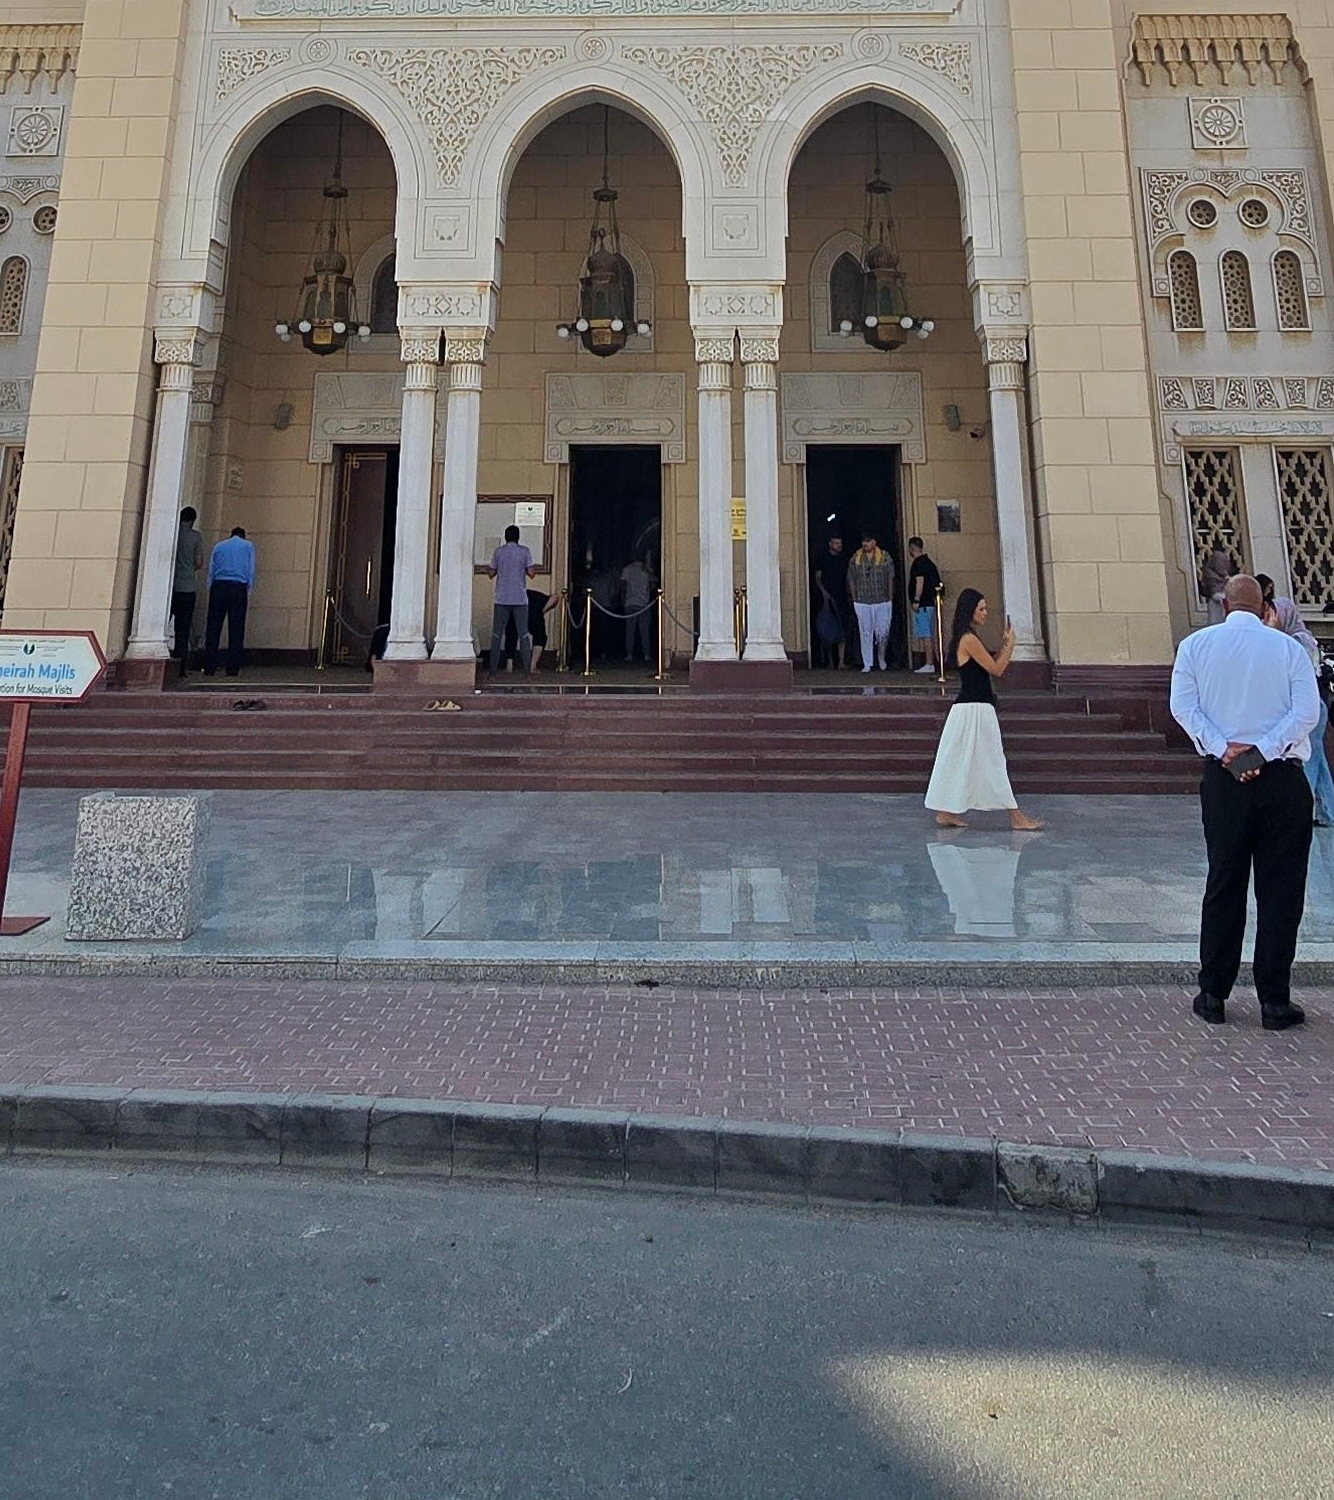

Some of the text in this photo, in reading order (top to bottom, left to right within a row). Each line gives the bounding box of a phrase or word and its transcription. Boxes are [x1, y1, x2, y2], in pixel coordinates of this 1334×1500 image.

[38, 664, 75, 682] Majlis
[16, 682, 26, 694] for
[27, 684, 53, 695] Mosque
[54, 684, 74, 695] Visits
